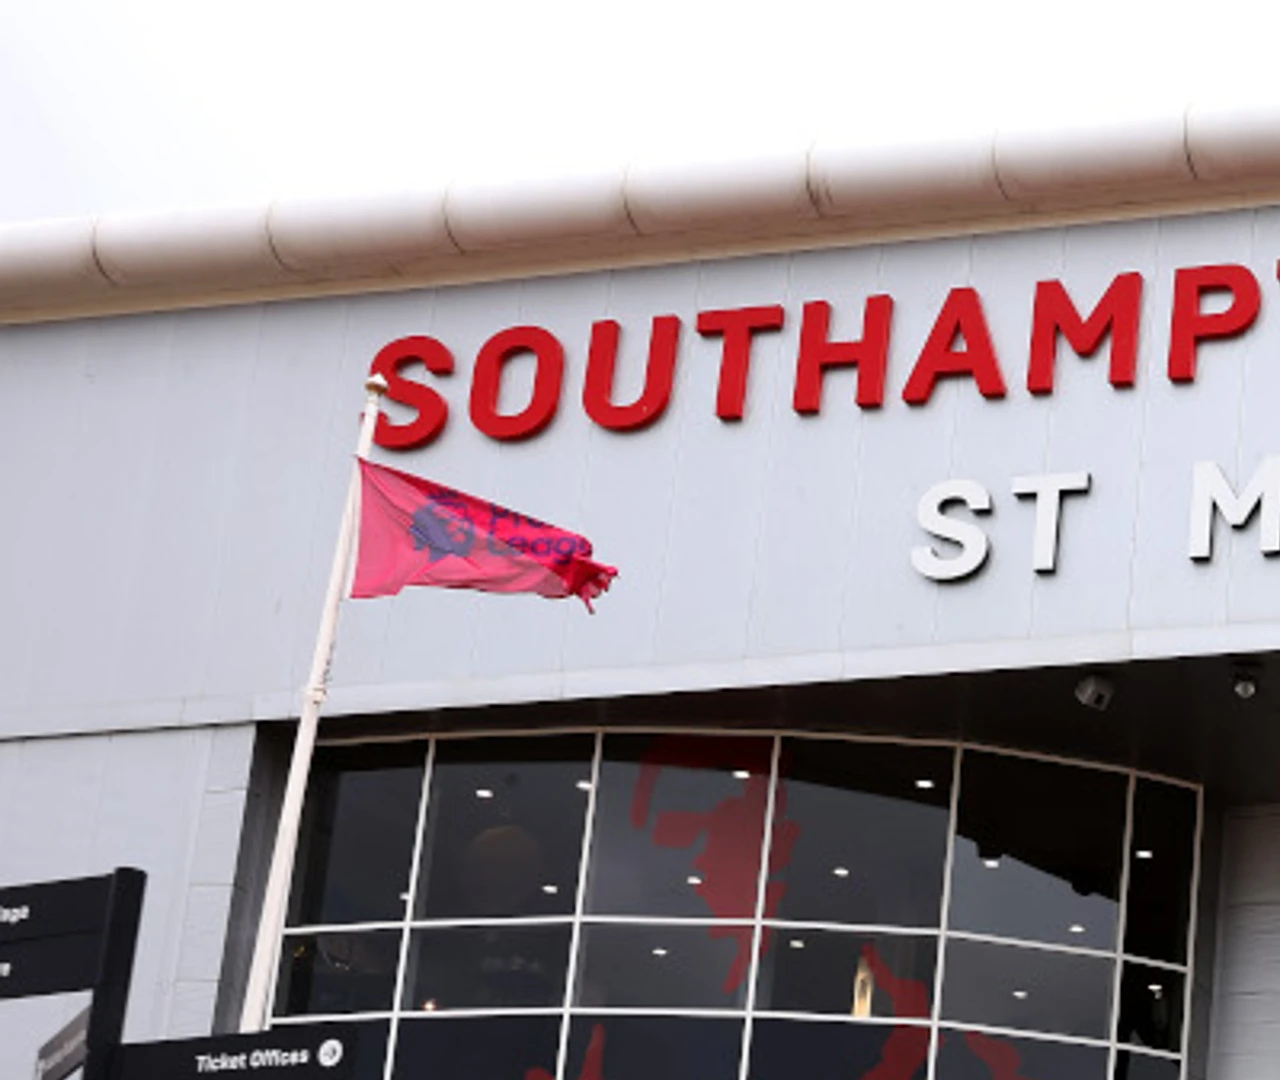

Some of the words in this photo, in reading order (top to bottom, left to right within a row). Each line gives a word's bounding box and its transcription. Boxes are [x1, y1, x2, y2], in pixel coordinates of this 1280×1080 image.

[911, 471, 1091, 583] ST
[195, 1053, 247, 1073] Ticket
[249, 1048, 310, 1068] Offices
